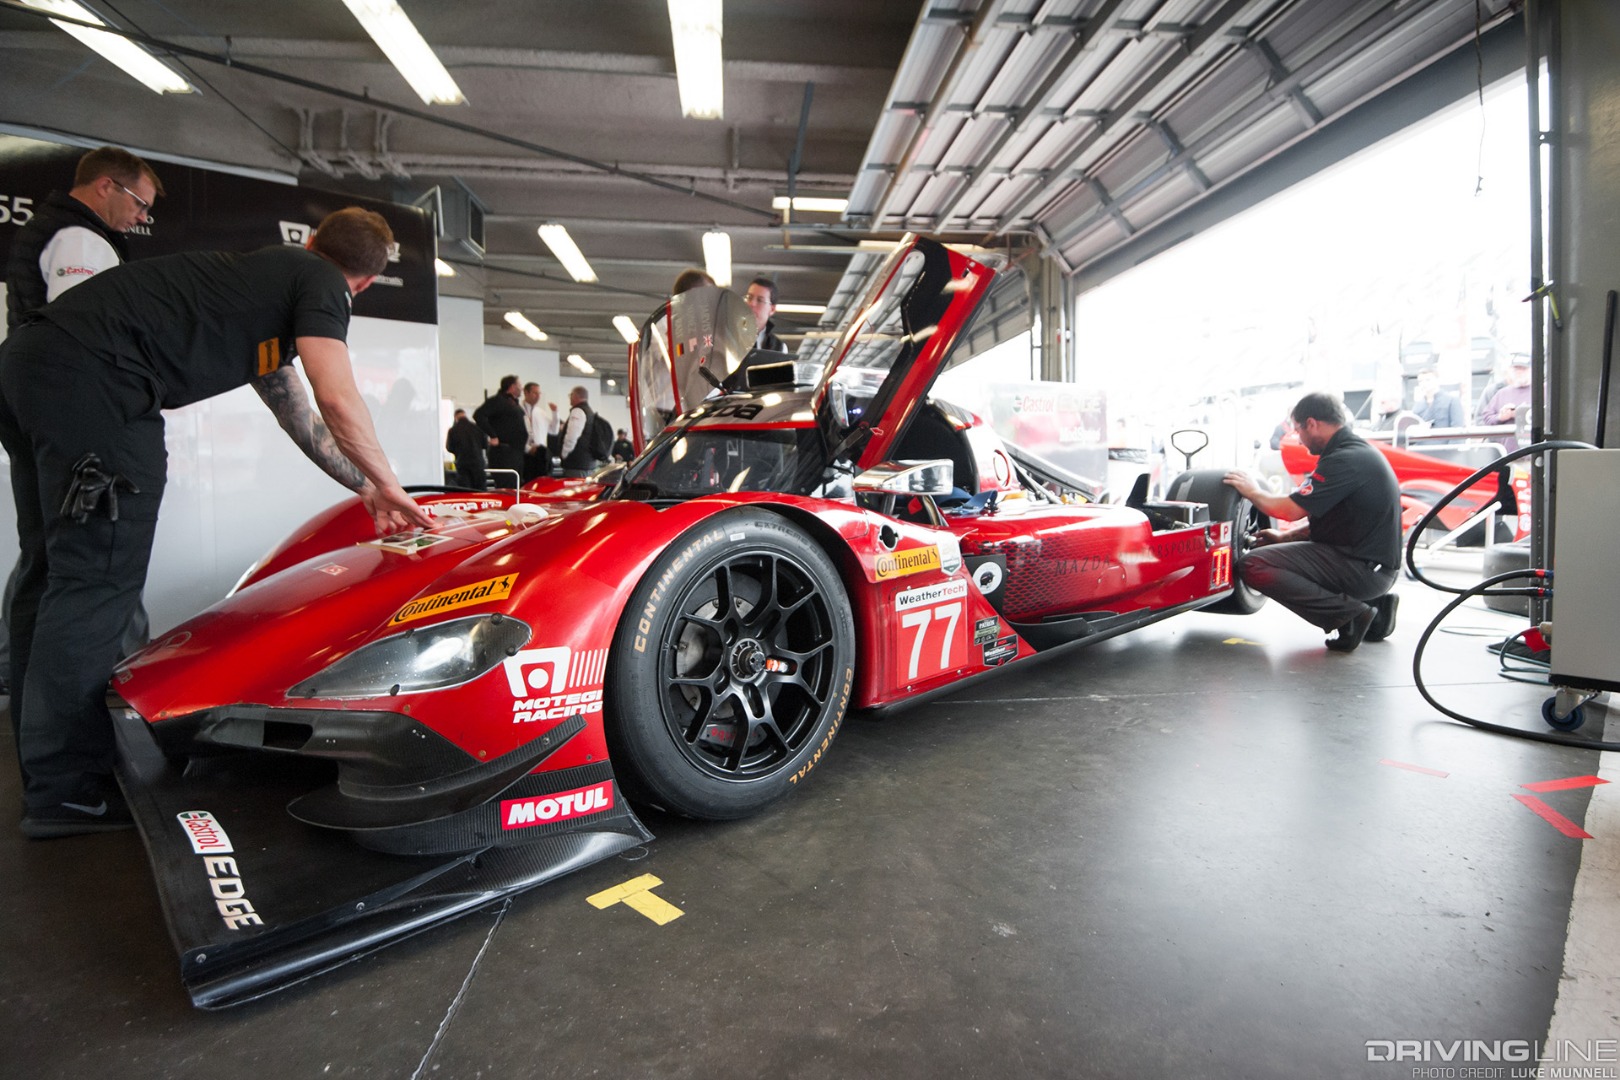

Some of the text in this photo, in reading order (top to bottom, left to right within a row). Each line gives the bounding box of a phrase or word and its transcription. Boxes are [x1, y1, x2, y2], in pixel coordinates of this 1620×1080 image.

[876, 550, 931, 578] Continental
[1054, 554, 1110, 577] MAZDA
[394, 580, 496, 623] Continental
[634, 530, 724, 653] CONTINENTAL
[899, 584, 964, 605] WeatherTech
[902, 601, 962, 680] 77
[512, 689, 604, 712] MOTEGI
[512, 701, 604, 723] RACING
[789, 667, 852, 785] CONTINENTAL
[507, 786, 609, 826] MOTUL
[185, 819, 226, 850] Castrol
[203, 855, 265, 930] EDGE
